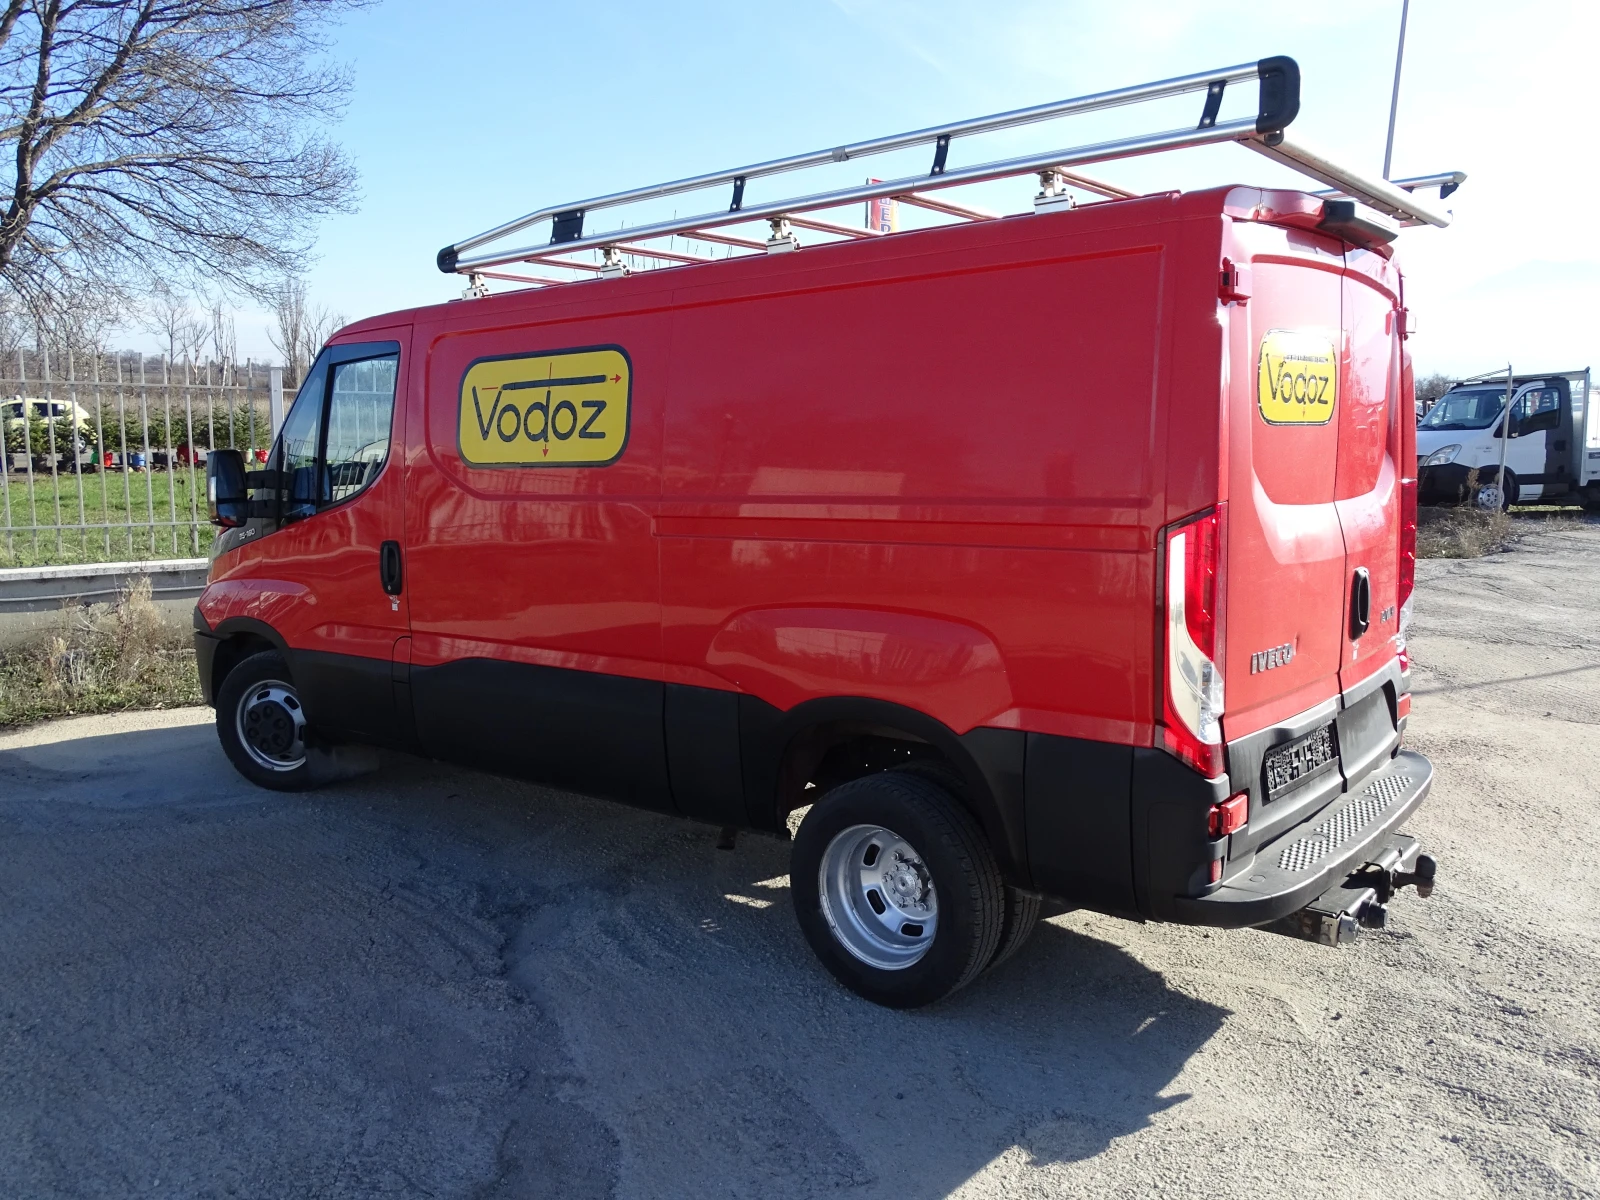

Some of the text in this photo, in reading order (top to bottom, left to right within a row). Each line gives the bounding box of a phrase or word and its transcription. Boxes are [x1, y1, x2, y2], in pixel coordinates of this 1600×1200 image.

[1265, 352, 1329, 405] Vodoz
[471, 385, 608, 443] Vodoz
[1250, 642, 1294, 676] IVECO
